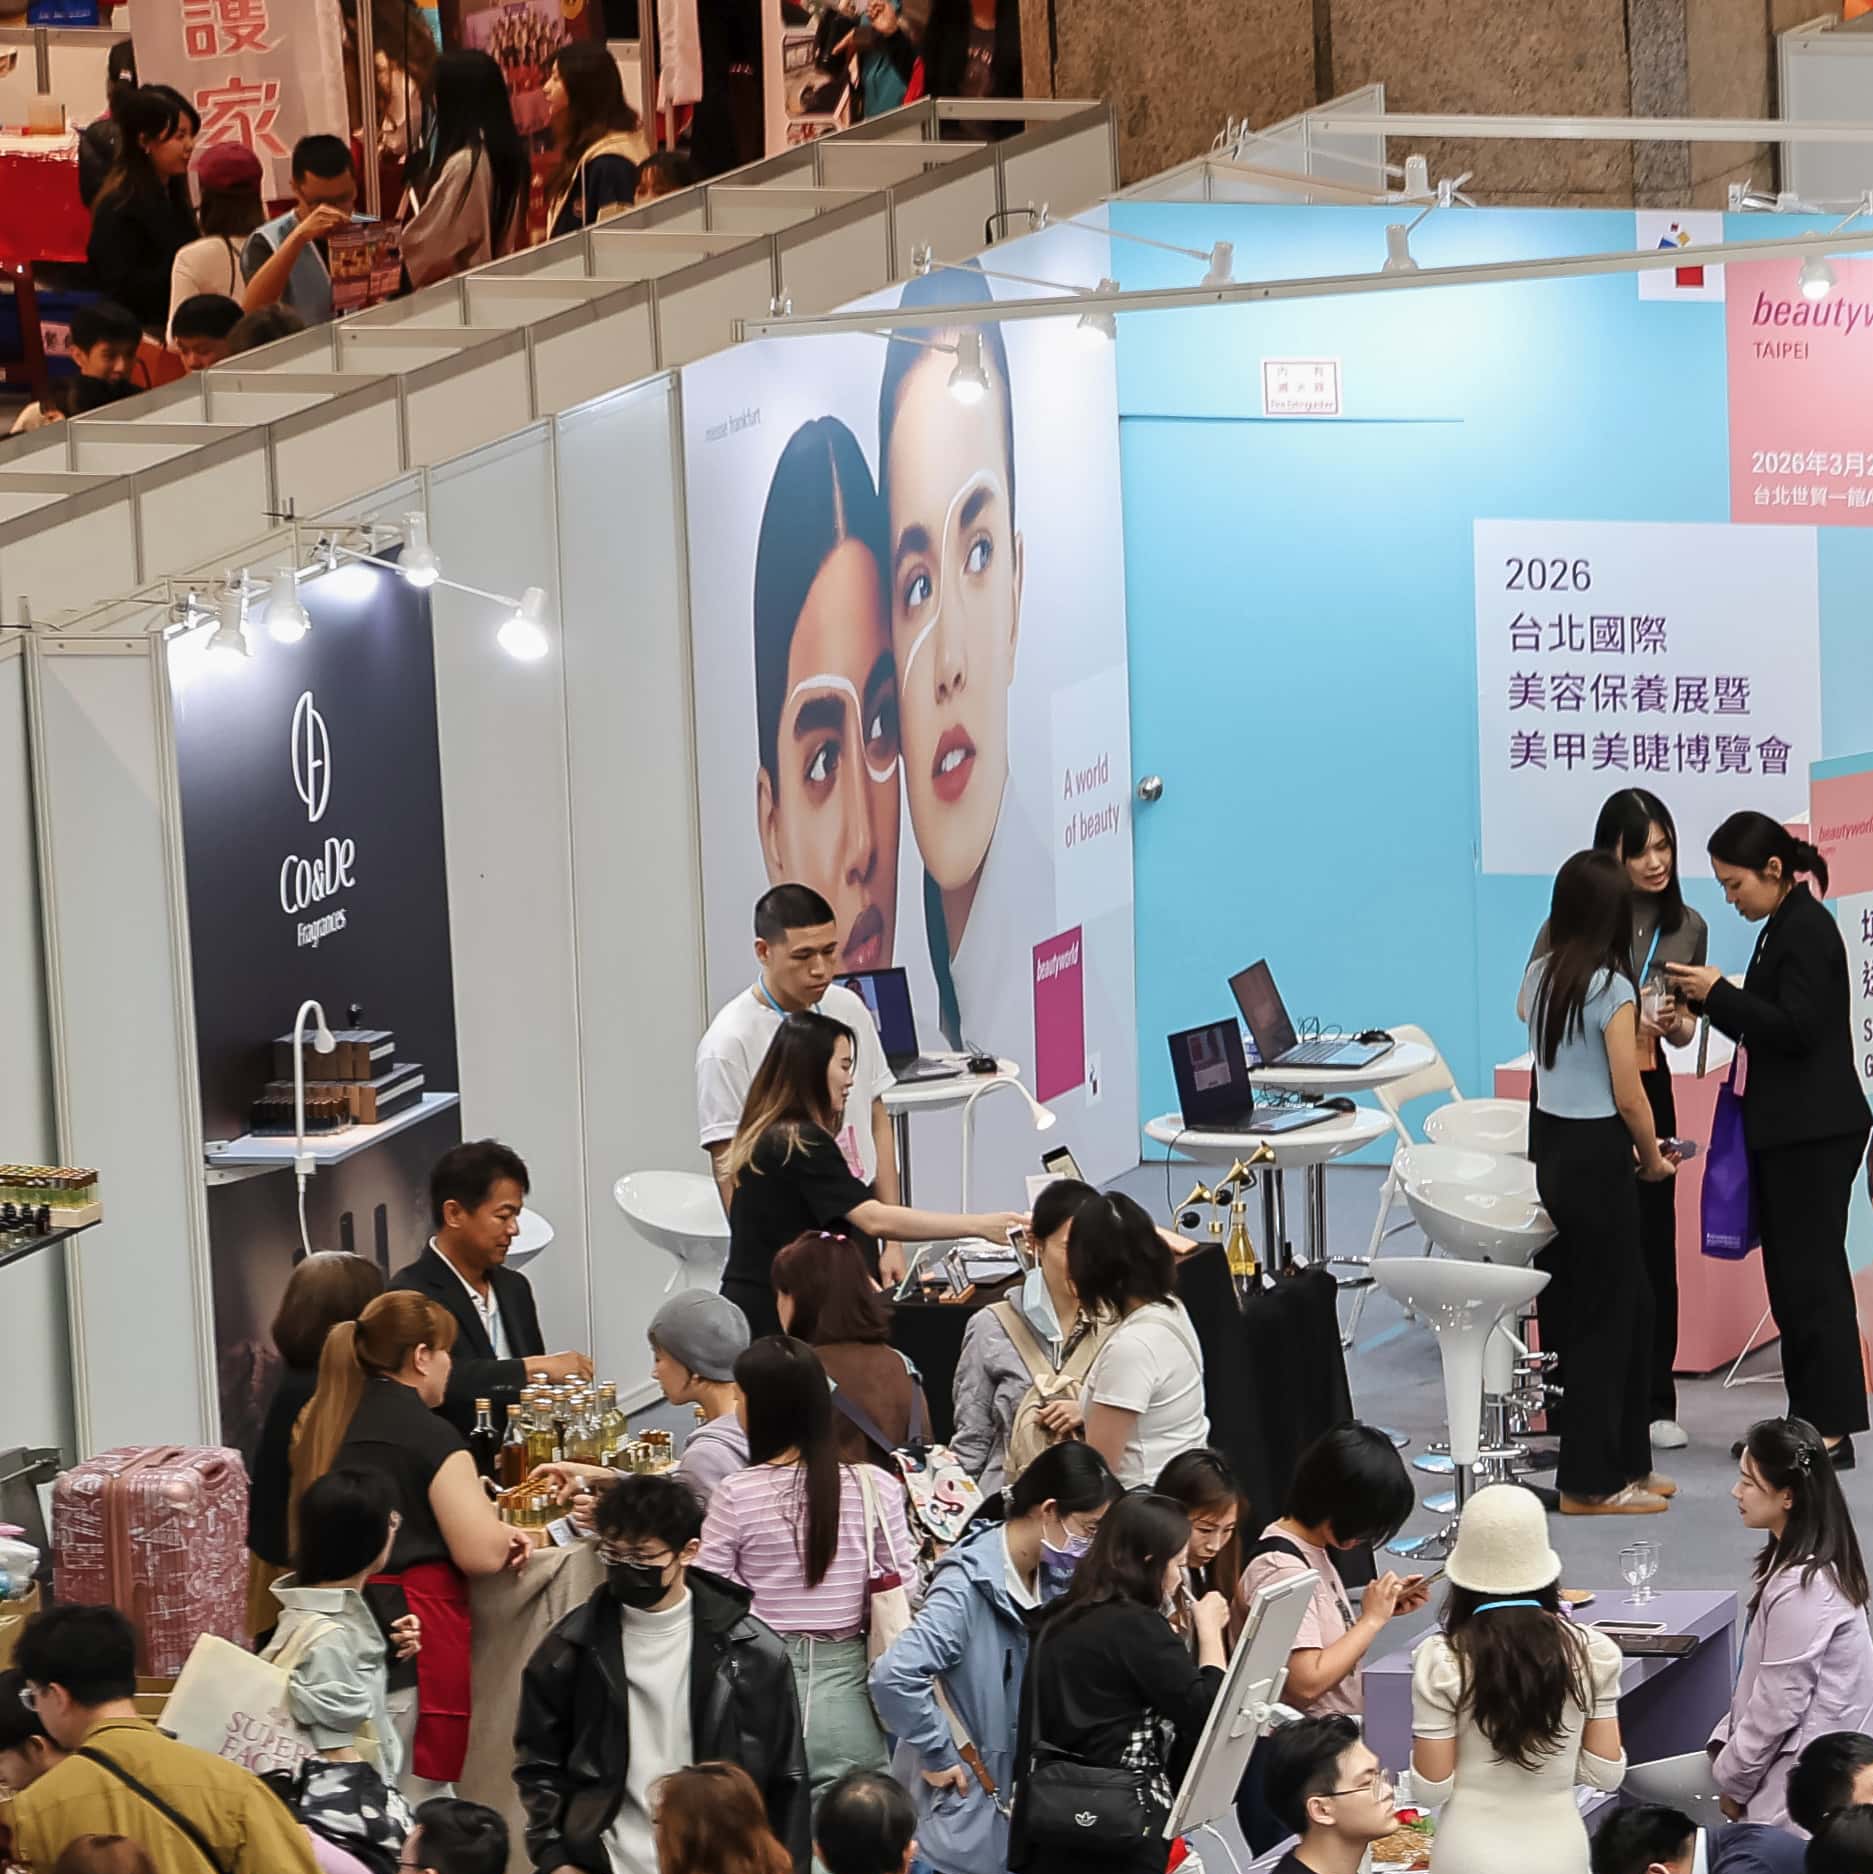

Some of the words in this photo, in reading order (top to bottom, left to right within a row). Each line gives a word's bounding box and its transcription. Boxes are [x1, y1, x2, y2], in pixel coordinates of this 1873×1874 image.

[1753, 341, 1809, 360] TAIPEI
[1505, 557, 1592, 592] 2026
[1508, 612, 1669, 656] 台北國際
[1508, 671, 1752, 716] 美容保養展暨
[1508, 730, 1793, 776] 美甲美睫博覽會
[1063, 767, 1074, 801] A
[1076, 752, 1110, 792] world
[1064, 815, 1080, 849] of
[1080, 800, 1121, 844] beauty
[296, 907, 347, 949] Fragrances
[1035, 937, 1081, 984] beautyworld
